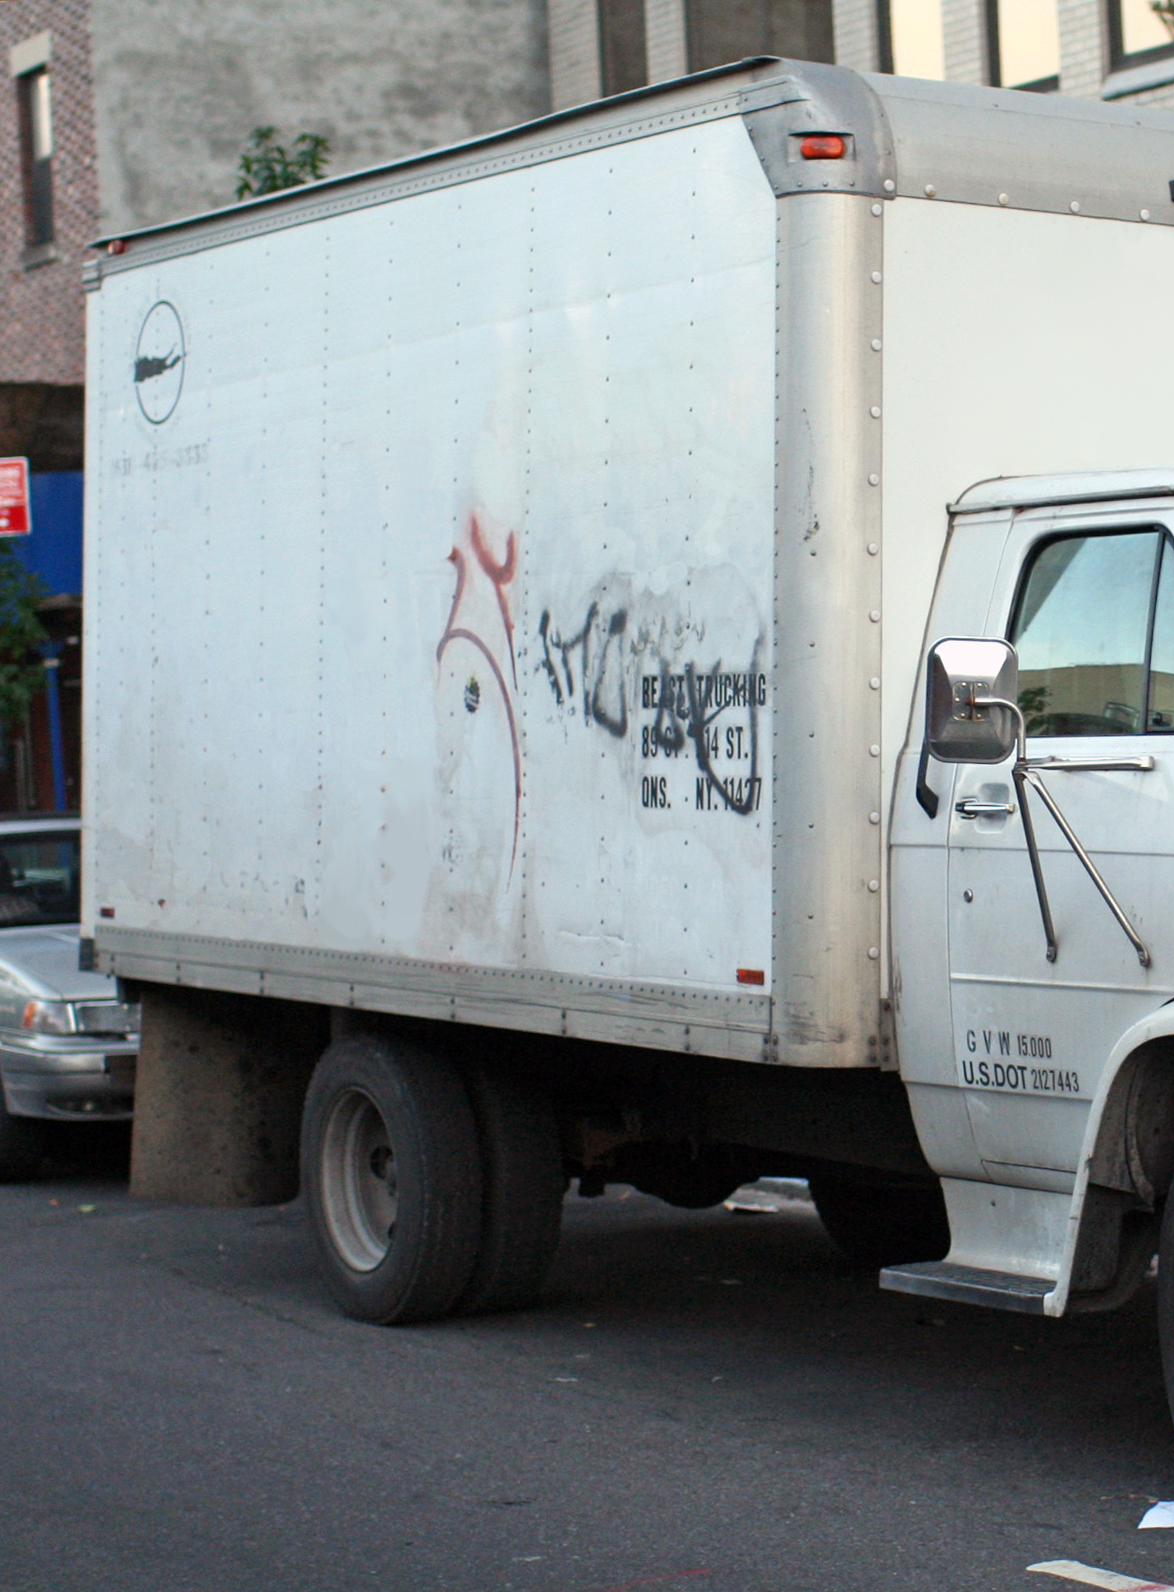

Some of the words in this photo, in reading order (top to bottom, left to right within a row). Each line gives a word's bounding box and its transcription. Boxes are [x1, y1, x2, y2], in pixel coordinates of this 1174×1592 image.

[642, 674, 684, 708] BEST
[696, 673, 766, 708] TRUCKING
[695, 726, 719, 759] 14
[726, 726, 748, 759] ST.
[642, 775, 671, 808] QNS.
[1030, 1068, 1080, 1093] 2127443
